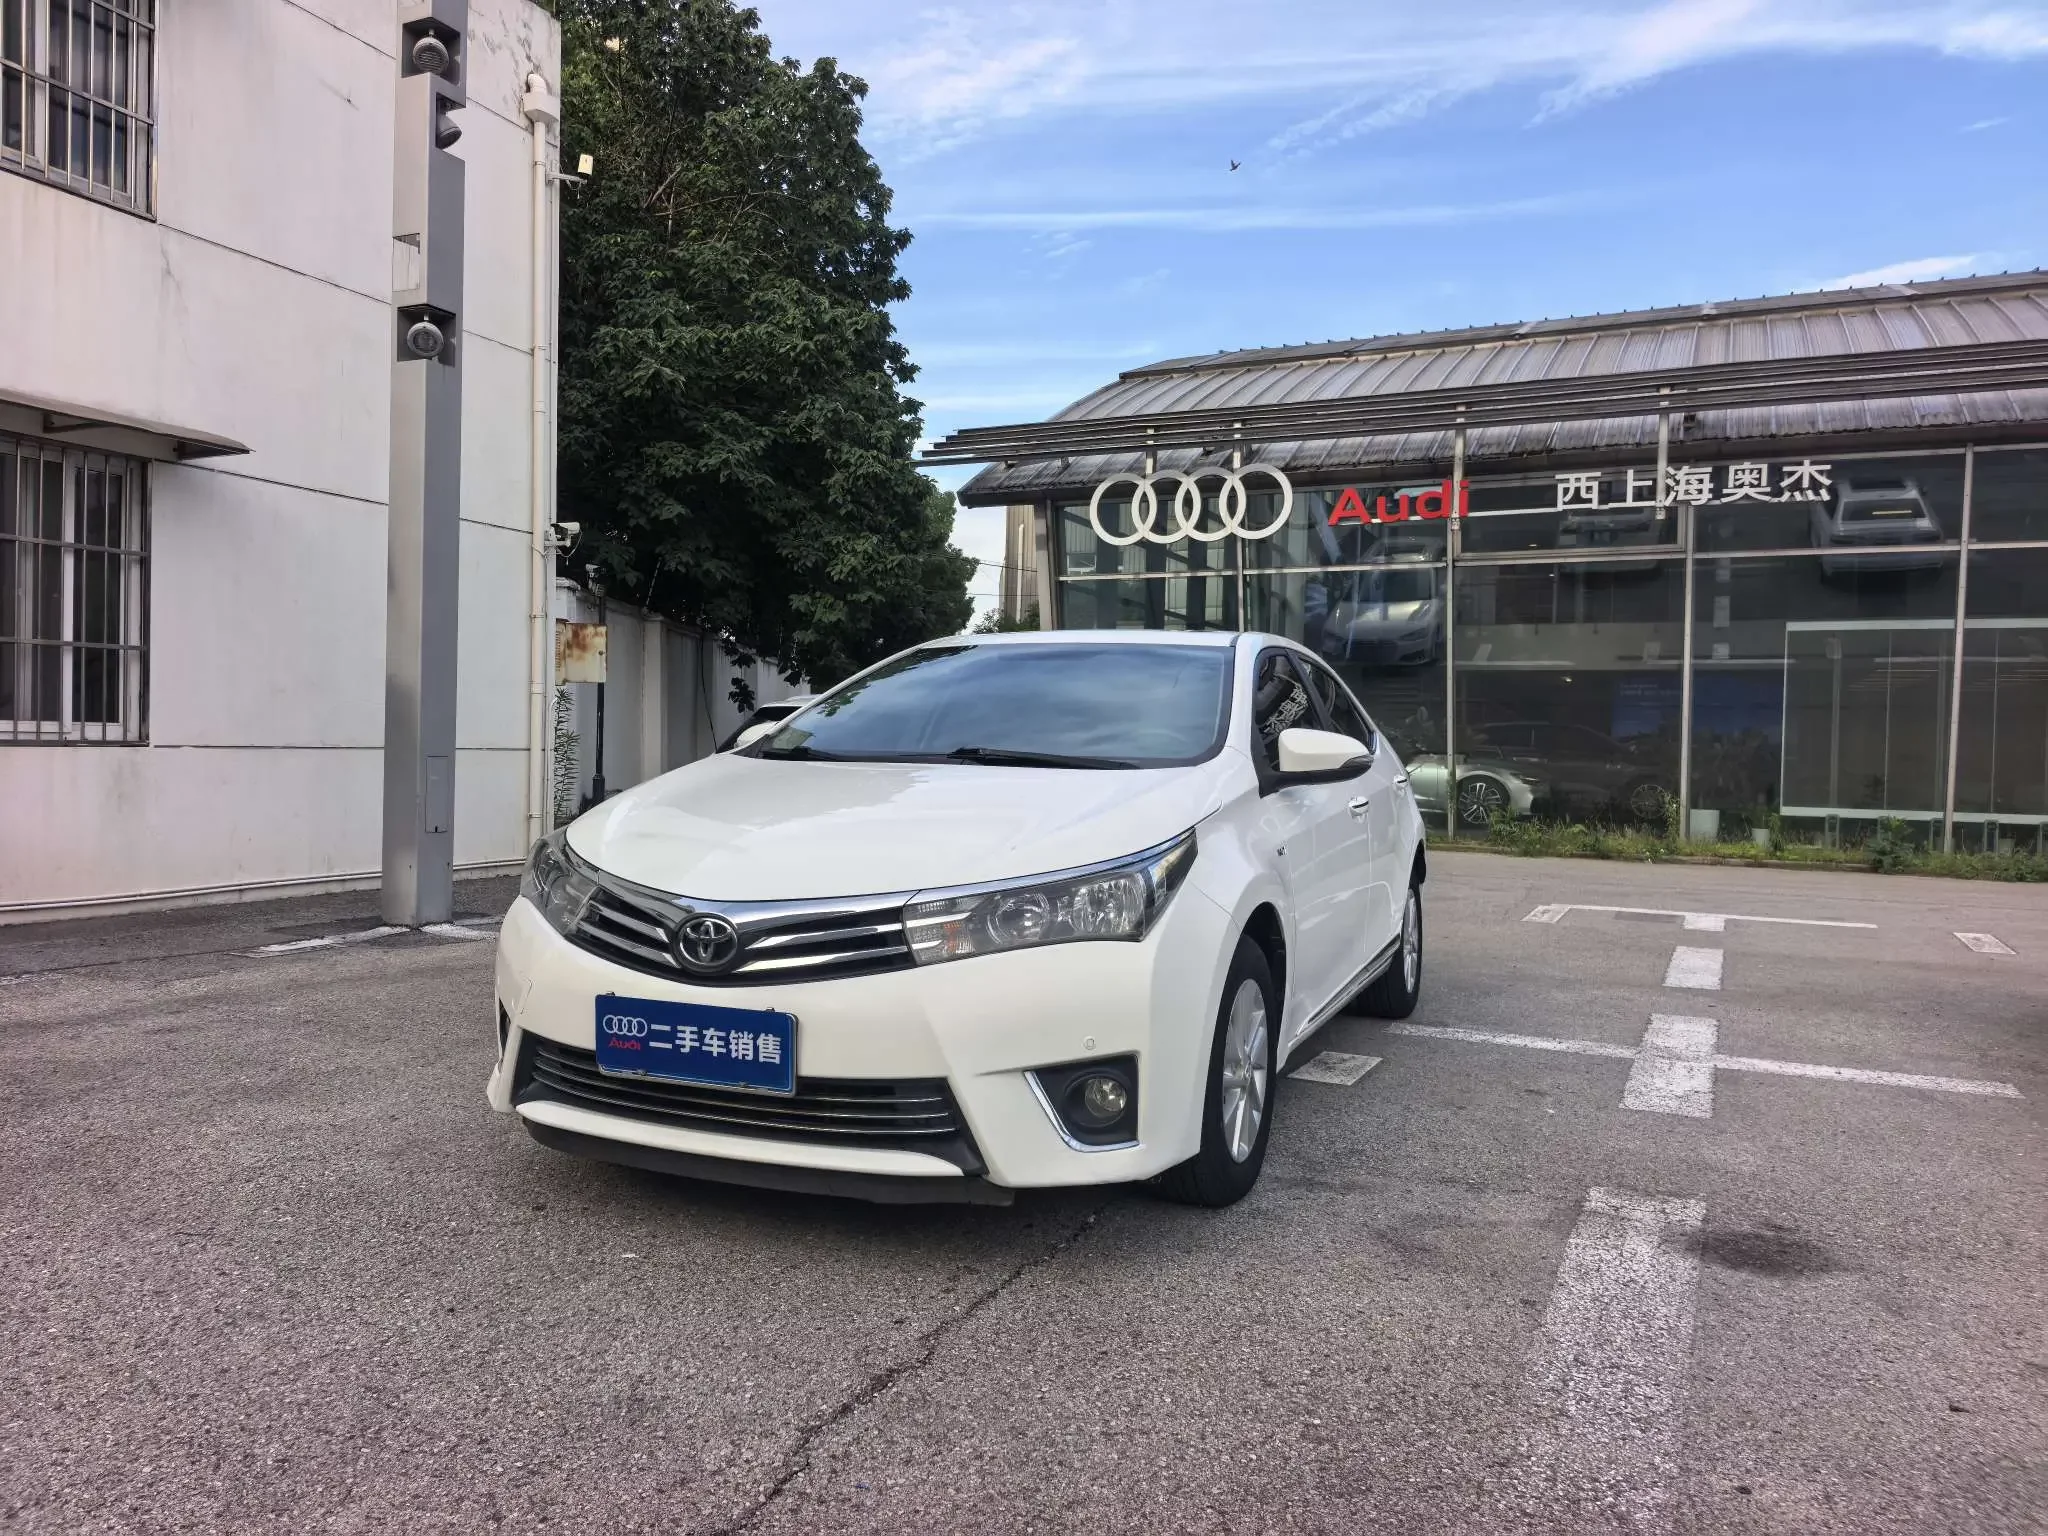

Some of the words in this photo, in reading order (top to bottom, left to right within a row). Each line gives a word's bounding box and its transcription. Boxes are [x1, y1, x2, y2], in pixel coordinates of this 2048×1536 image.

[1327, 478, 1470, 527] Audi
[1554, 459, 1833, 511] 西上海奥杰
[608, 1037, 641, 1050] Audi
[648, 1023, 782, 1065] 二手车销售
